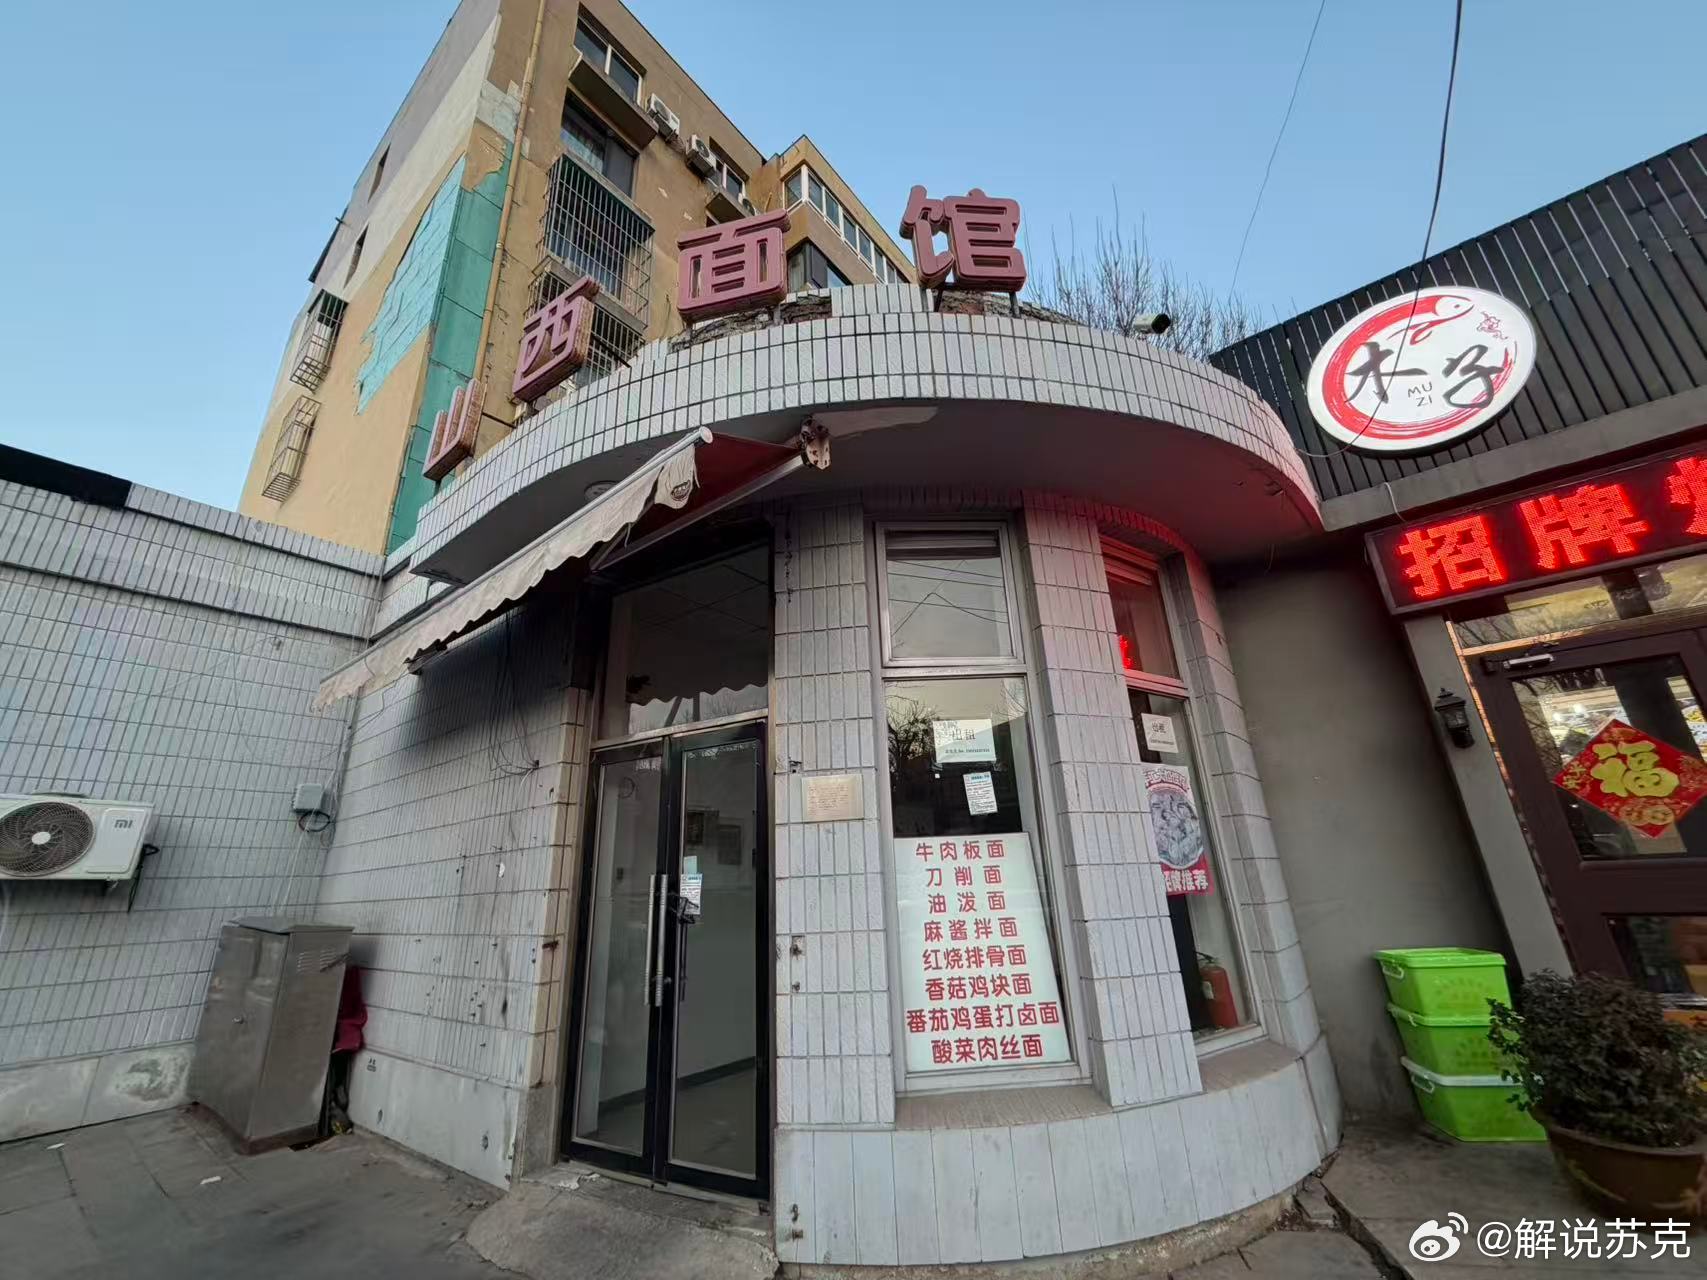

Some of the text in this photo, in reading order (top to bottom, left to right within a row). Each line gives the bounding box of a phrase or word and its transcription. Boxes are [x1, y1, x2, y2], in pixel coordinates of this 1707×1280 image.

[422, 185, 1027, 481] 山西面馆
[1345, 341, 1505, 409] 木子
[1407, 382, 1433, 398] MU
[1416, 396, 1433, 408] ZI
[1590, 740, 1681, 798] 福
[915, 839, 1005, 862] 牛肉板面
[925, 865, 1003, 887] 刀削面
[928, 890, 1006, 914] 油泼面
[924, 916, 1018, 943] 麻酱拌面
[922, 944, 1027, 971] 红烧排骨面
[925, 972, 1032, 1001] 香菇鸡块面
[906, 1001, 1060, 1033] 番茄鸡蛋打卤面
[931, 1033, 1043, 1065] 酸菜肉丝面
